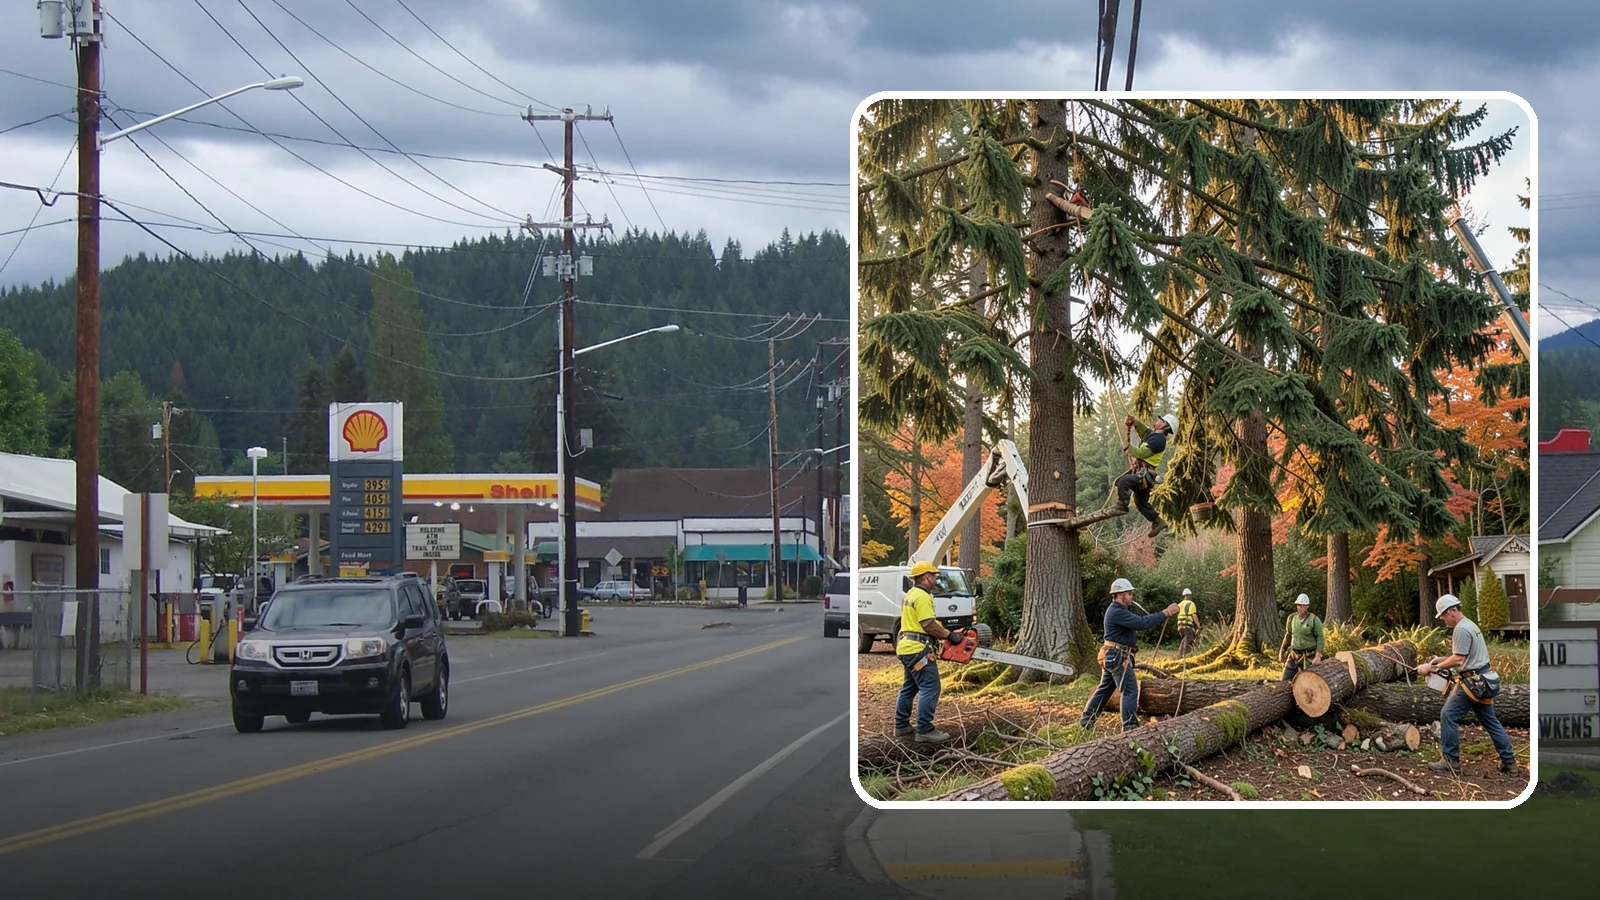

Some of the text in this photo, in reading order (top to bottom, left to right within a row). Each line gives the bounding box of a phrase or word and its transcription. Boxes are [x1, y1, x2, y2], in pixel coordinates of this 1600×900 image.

[366, 480, 383, 490] 395
[490, 484, 547, 499] Shell
[366, 494, 383, 504] 405
[366, 508, 383, 518] 415
[366, 522, 383, 532] 429
